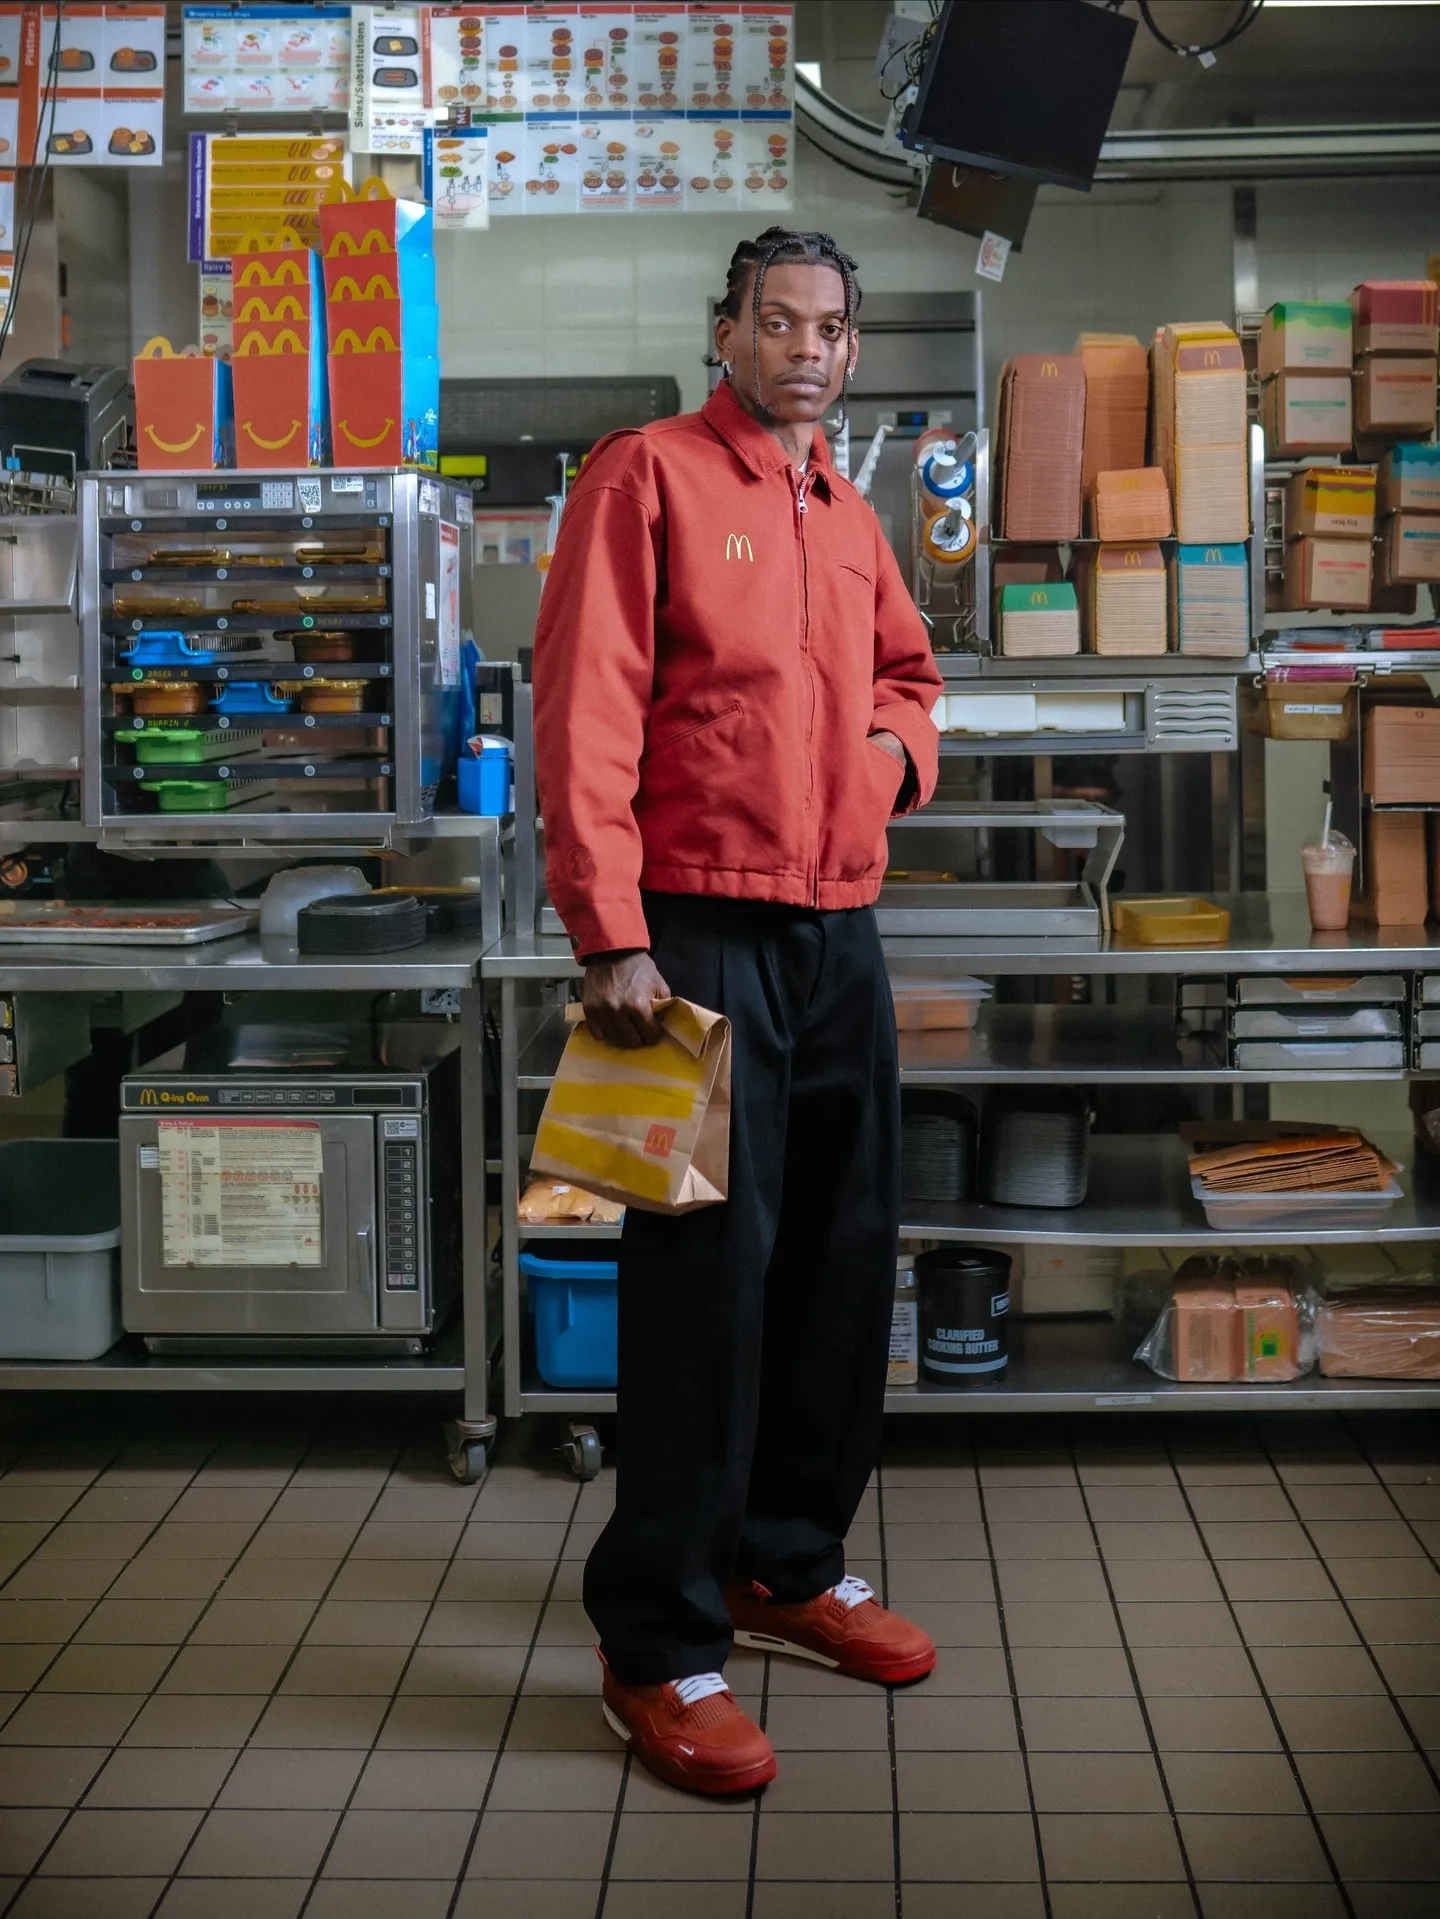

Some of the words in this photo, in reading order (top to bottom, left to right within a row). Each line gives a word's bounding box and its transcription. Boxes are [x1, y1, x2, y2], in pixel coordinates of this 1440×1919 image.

[25, 21, 36, 66] Platters
[354, 22, 366, 128] Sides/Substitutions
[160, 1092, 184, 1104] Q-ing
[186, 1092, 210, 1103] Oven
[936, 1328, 985, 1342] CLARIFIED
[927, 1338, 964, 1354] COOKING
[964, 1339, 999, 1354] BUTTER
